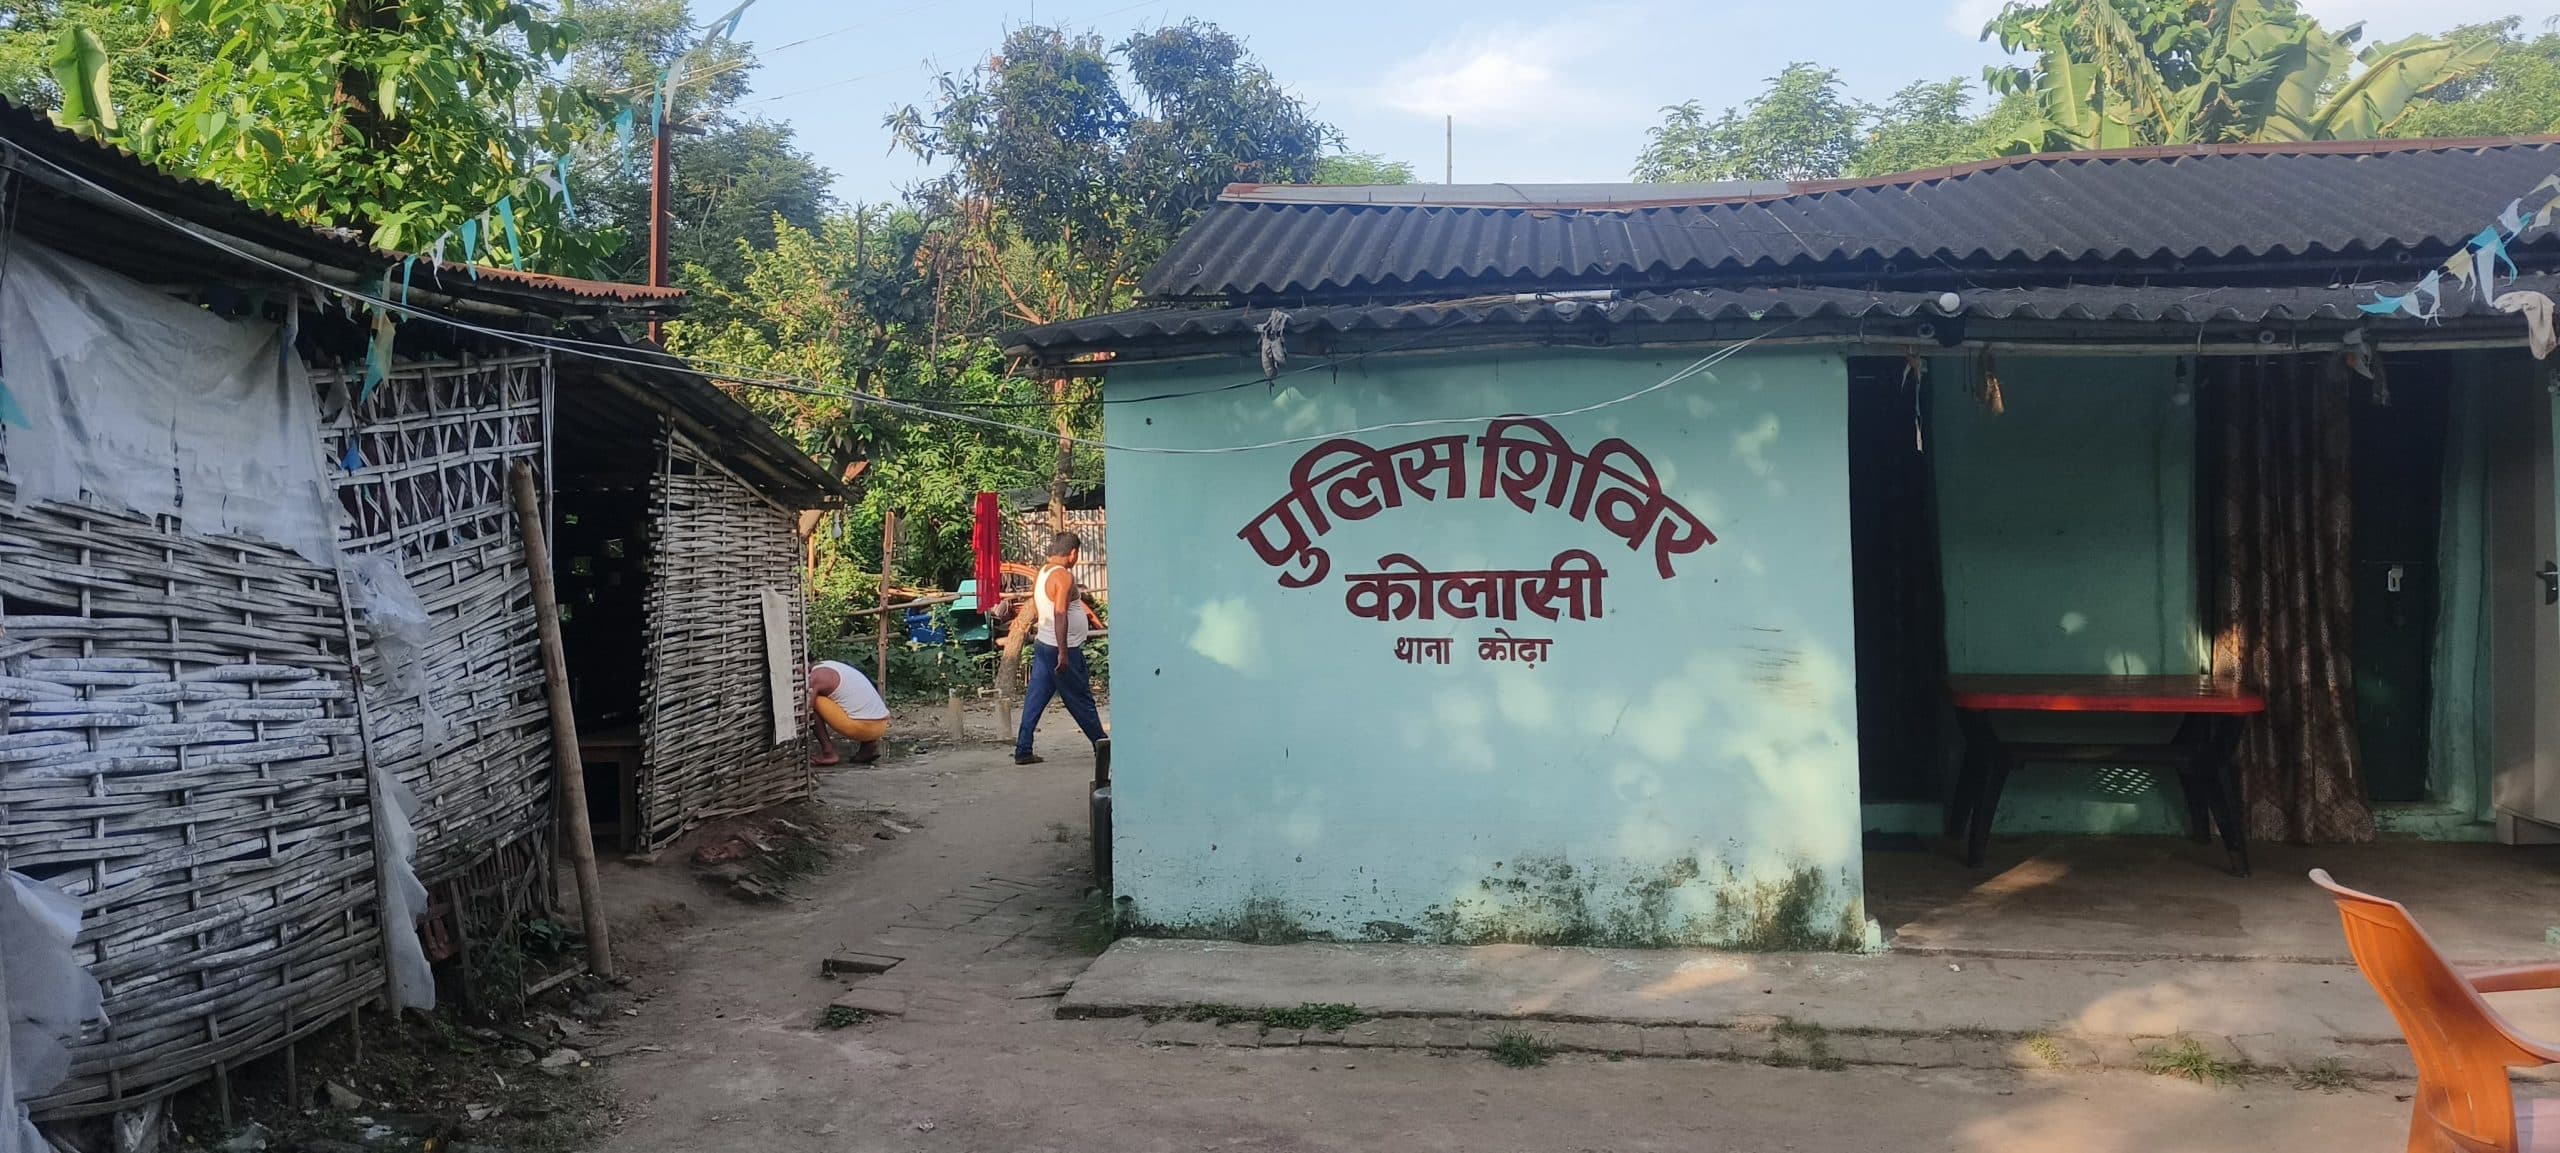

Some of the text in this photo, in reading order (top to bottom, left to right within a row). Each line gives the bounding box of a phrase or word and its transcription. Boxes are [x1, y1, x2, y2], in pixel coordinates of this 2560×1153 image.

[1237, 414, 1717, 588] पुलिस शिविर
[1345, 549, 1608, 622] कोलासी
[1394, 627, 1553, 669] थाना कोढ़ा
